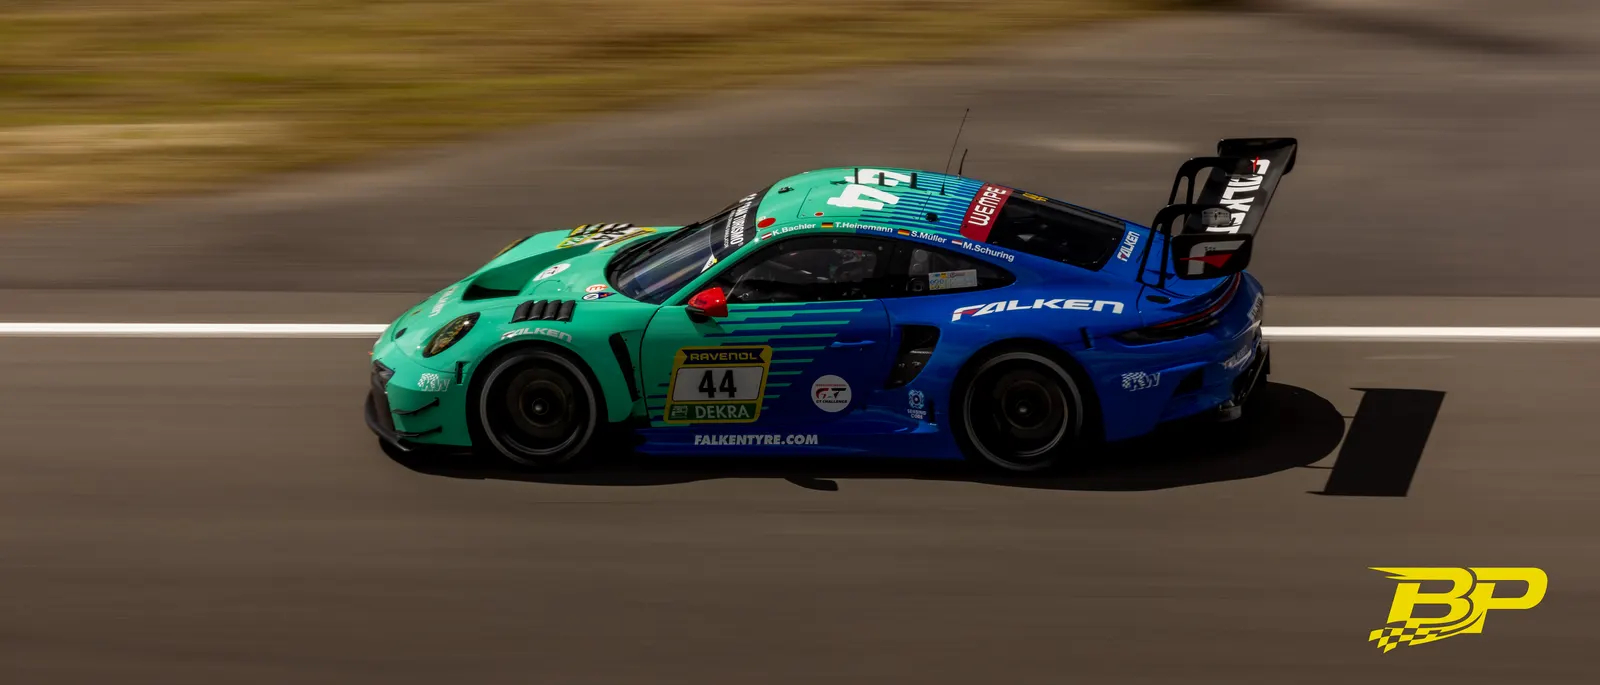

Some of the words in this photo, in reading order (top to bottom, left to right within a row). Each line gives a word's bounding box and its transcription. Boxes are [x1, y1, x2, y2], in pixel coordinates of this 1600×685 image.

[968, 186, 1007, 226] WEMPE
[772, 223, 816, 236] K.Bachler
[835, 221, 893, 233] T.Heinemann
[911, 230, 947, 244] S.Müller
[962, 241, 1015, 263] M.Schuring
[1117, 230, 1140, 262] FALKEN
[952, 298, 1124, 322] FALKEN
[501, 327, 572, 343] FALKEN
[690, 352, 758, 361] RAVENOL
[418, 372, 451, 392] KW
[698, 370, 737, 398] 44
[694, 405, 750, 419] DEKRA
[694, 434, 818, 446] FALKENTYRE.COM
